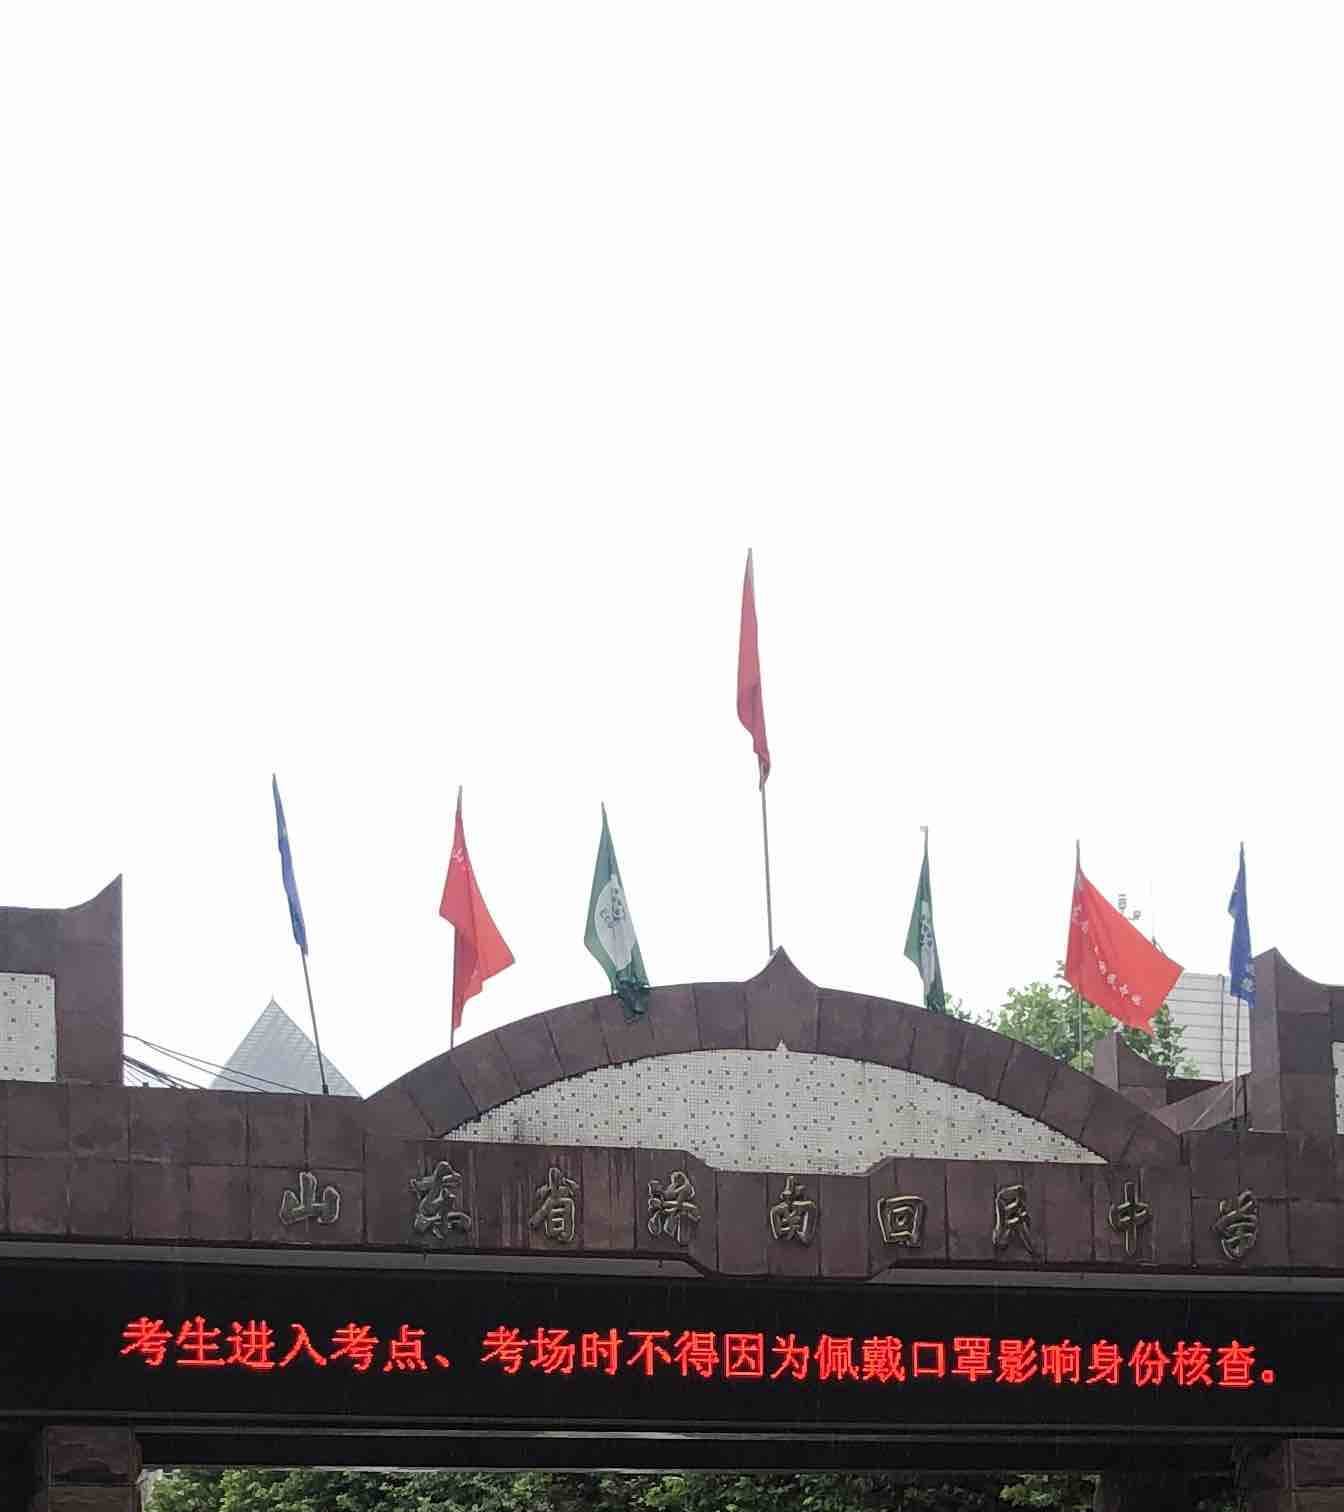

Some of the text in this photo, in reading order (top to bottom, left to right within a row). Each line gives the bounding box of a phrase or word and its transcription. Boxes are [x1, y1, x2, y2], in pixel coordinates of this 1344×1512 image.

[118, 1314, 1277, 1390] 考生进入考点、考场时不得因为佩戴口罩影响身份核查。
